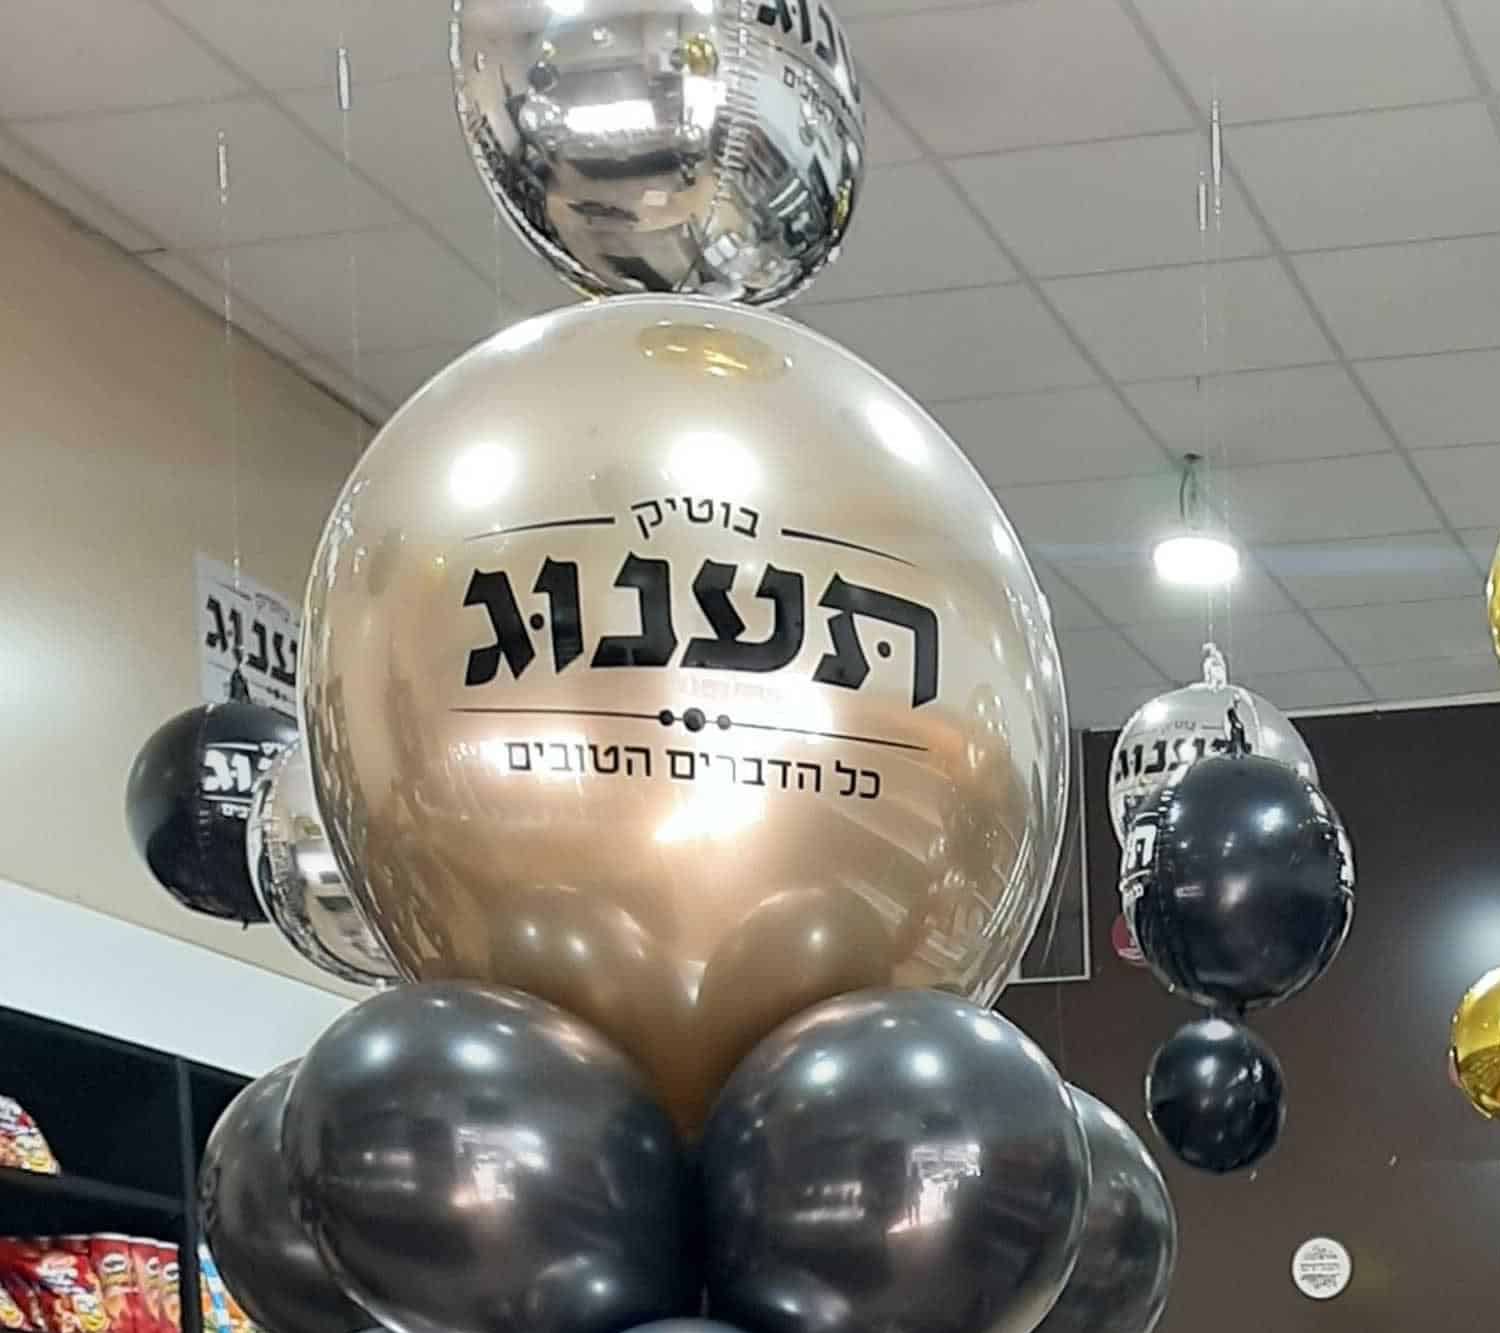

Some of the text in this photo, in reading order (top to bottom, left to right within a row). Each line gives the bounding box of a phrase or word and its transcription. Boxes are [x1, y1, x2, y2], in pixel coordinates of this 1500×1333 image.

[631, 497, 760, 540] בוטיק
[463, 551, 939, 709] תענוג
[503, 741, 881, 800] כל הדברים הטובים
